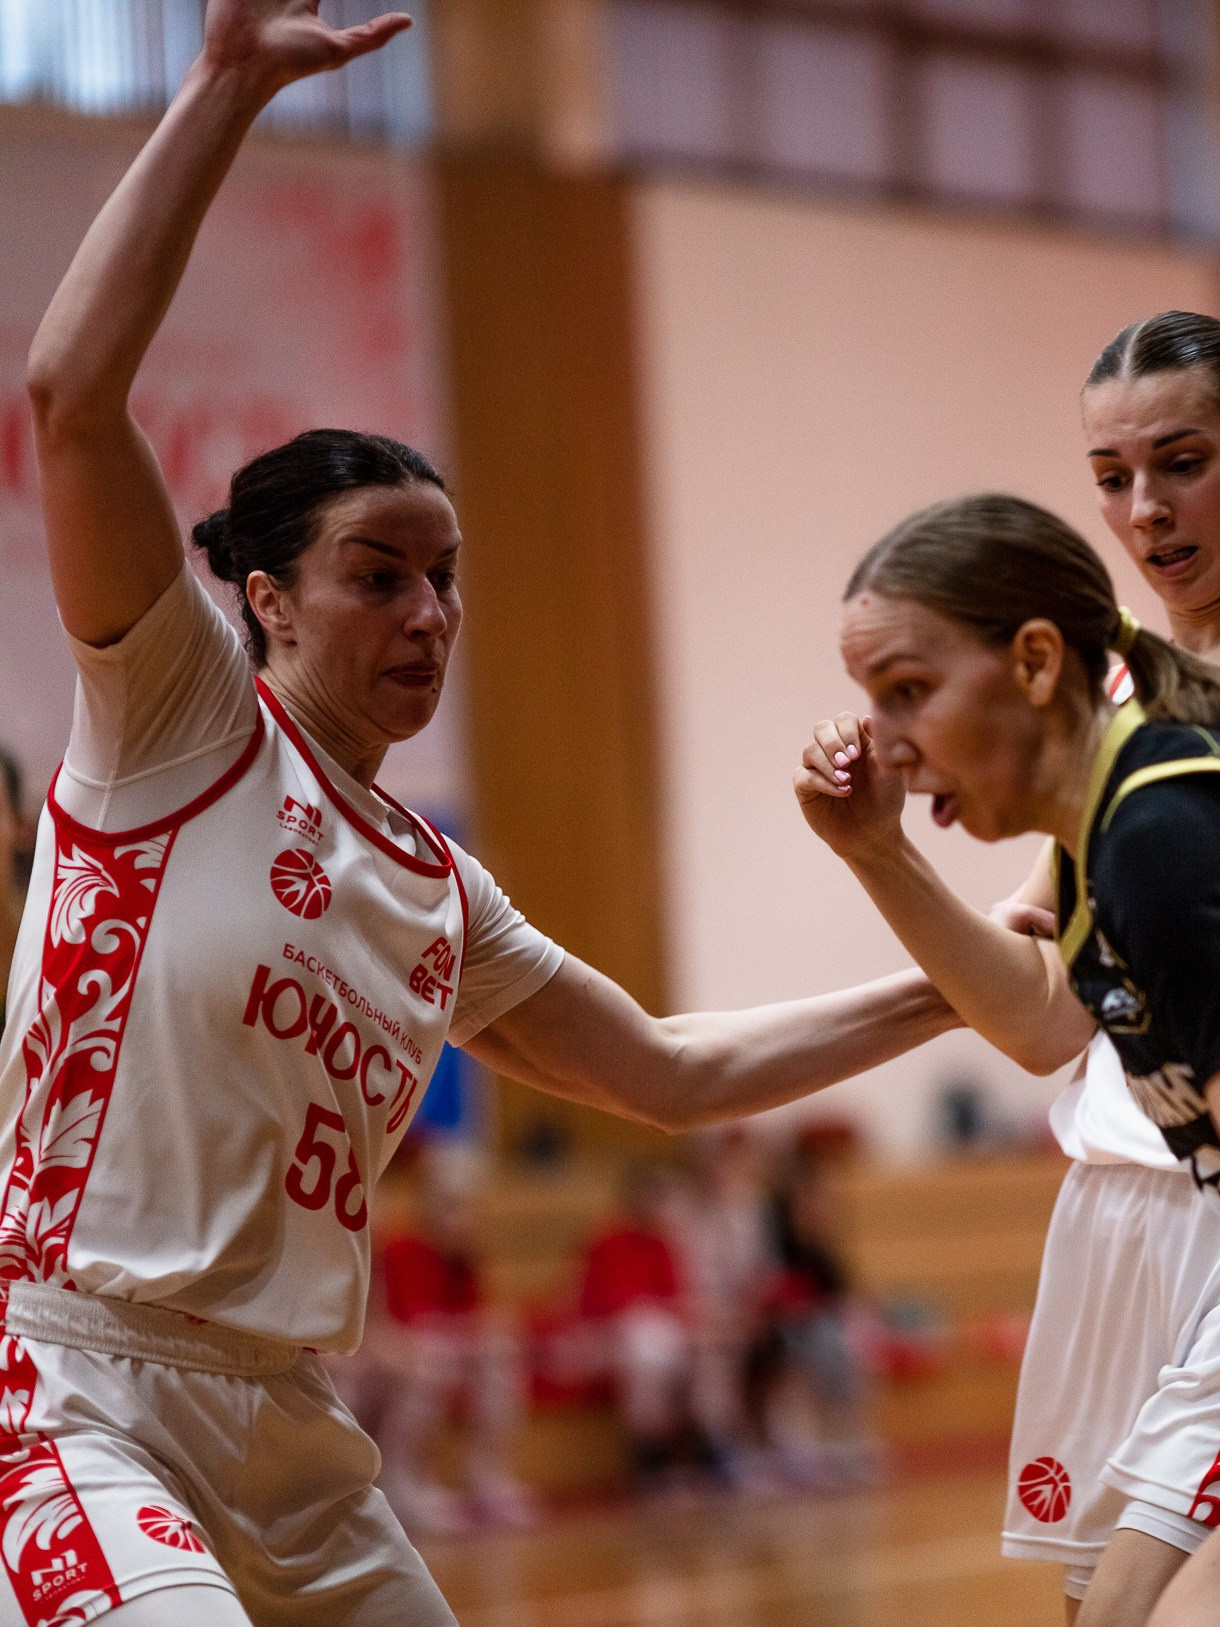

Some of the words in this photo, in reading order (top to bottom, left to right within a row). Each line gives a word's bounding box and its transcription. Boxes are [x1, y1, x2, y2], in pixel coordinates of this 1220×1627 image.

[276, 809, 324, 842] SPORT
[421, 936, 457, 982] FON
[282, 943, 401, 1041] БАСКЕТБОЛЬНЫЙ
[399, 1036, 423, 1065] КЛУБ
[409, 963, 454, 1012] BET
[32, 1562, 88, 1602] SPORT
